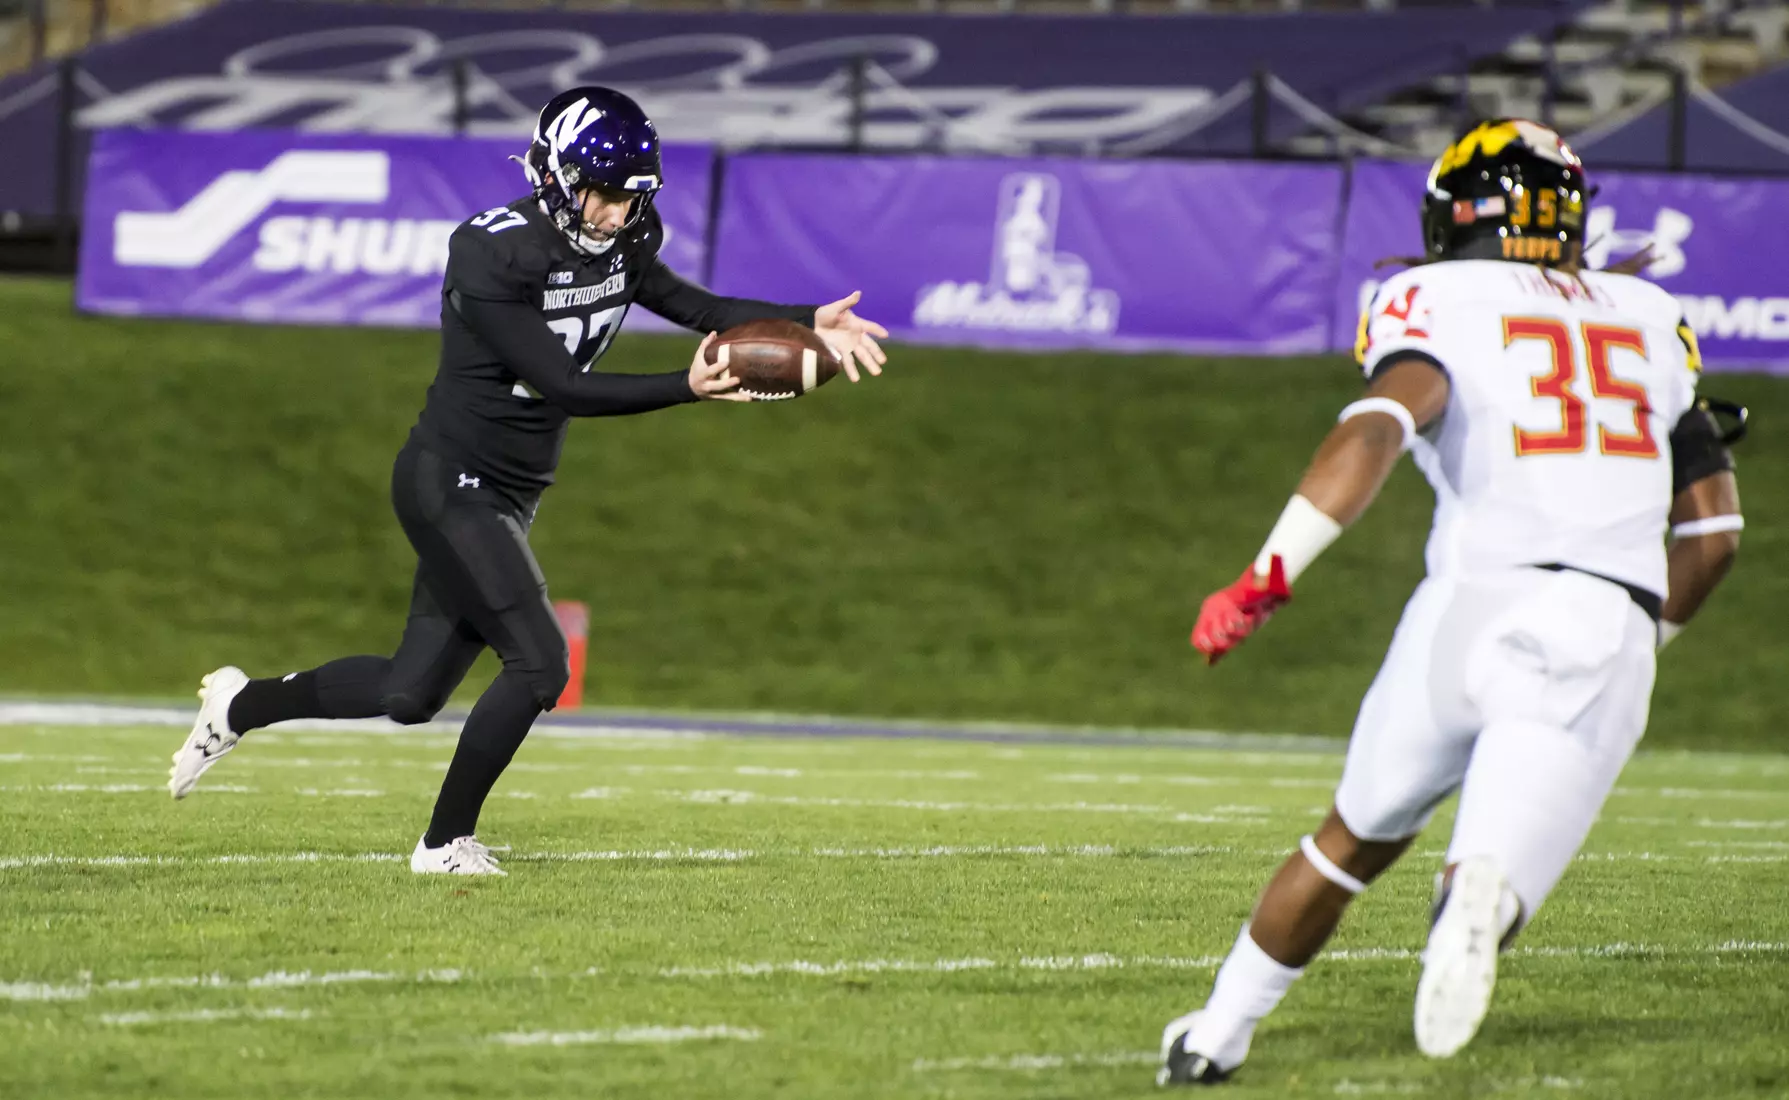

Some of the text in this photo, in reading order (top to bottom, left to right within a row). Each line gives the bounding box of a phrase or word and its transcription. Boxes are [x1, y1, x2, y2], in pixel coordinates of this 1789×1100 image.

[470, 206, 528, 233] 37
[1510, 187, 1558, 227] 35
[254, 215, 462, 276] SHUR
[1501, 314, 1659, 459] 35
